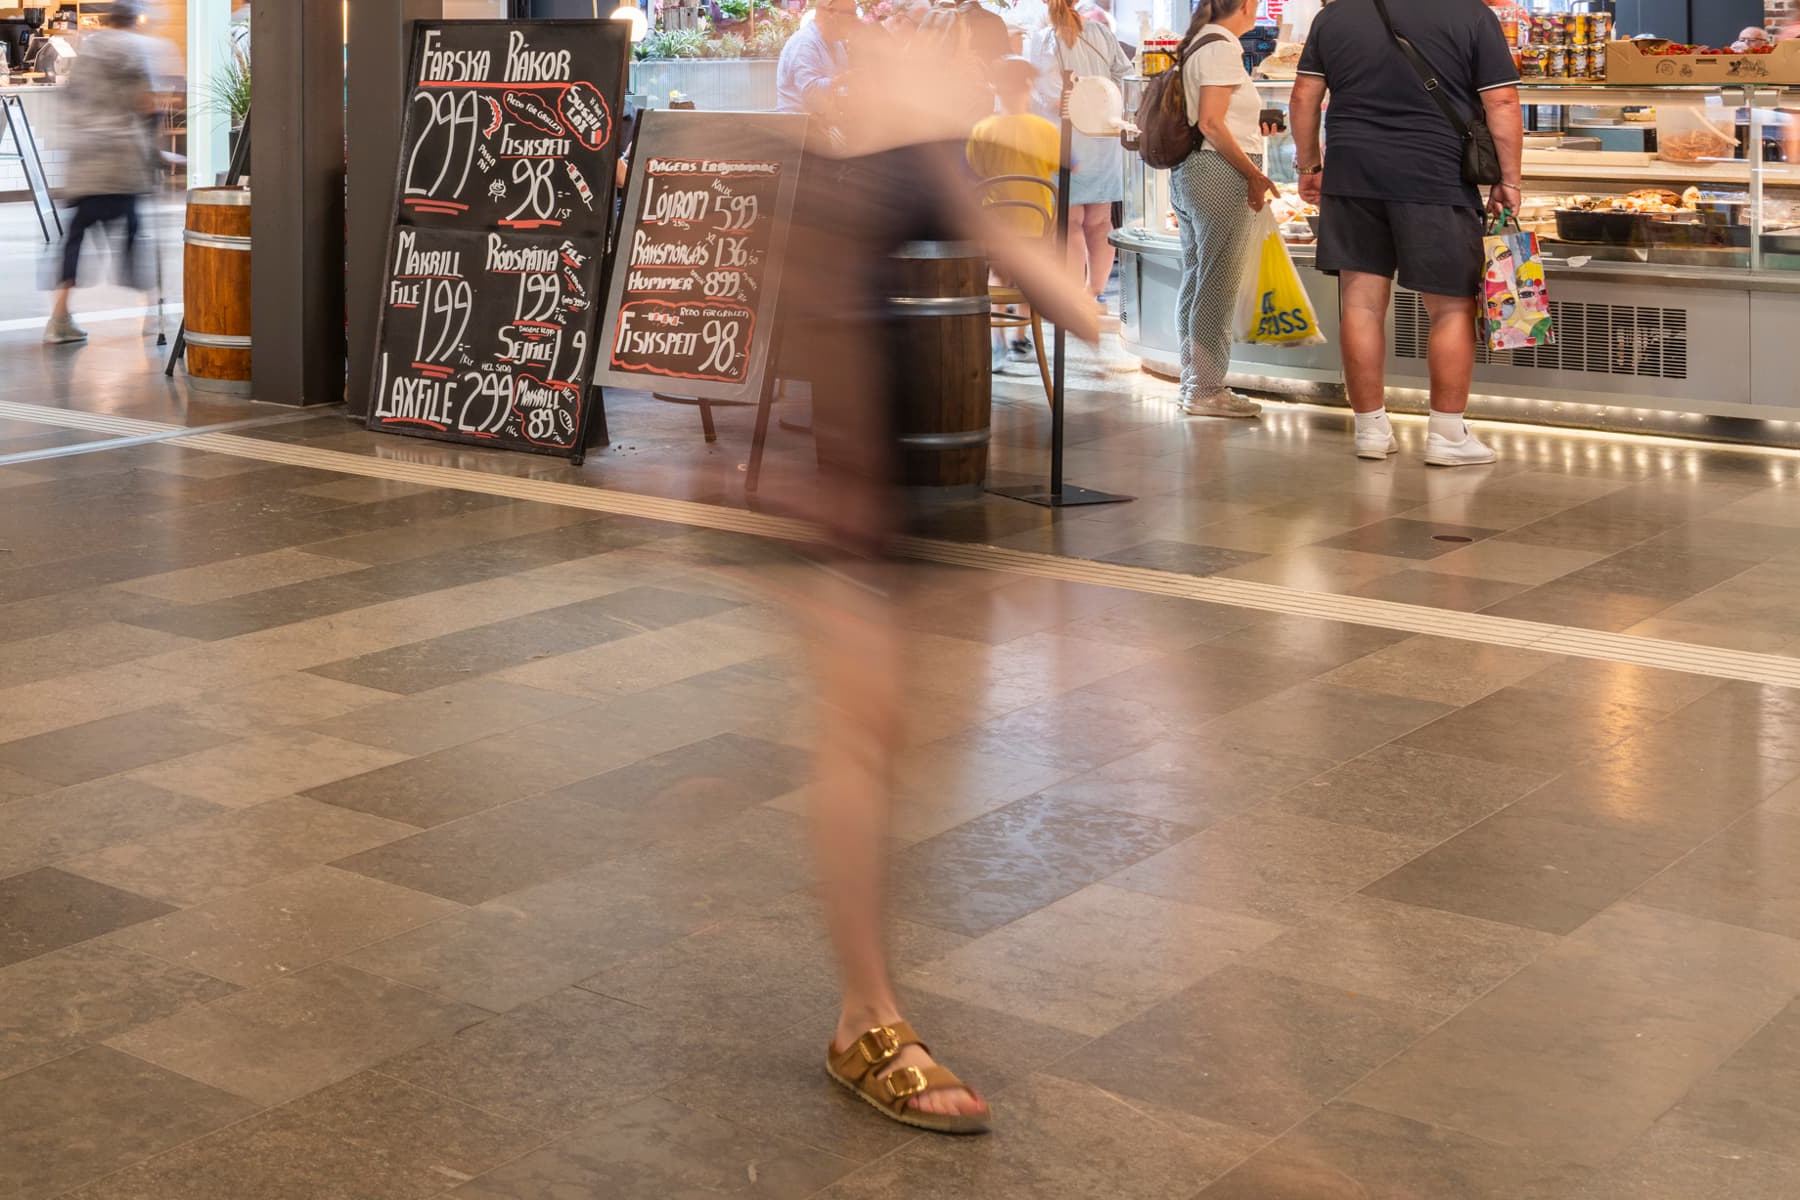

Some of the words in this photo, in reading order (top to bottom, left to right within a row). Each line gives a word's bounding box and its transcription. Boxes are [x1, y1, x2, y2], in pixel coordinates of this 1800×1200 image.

[504, 30, 571, 82] RÄKOR
[404, 90, 479, 198] 299
[648, 159, 697, 173] DAGENS
[642, 177, 709, 226] LÖJROM
[394, 231, 464, 277] MAKRILL
[628, 270, 694, 291] HUMMER
[616, 311, 702, 356] FISKSPETT
[514, 379, 560, 410] MAKRILL
